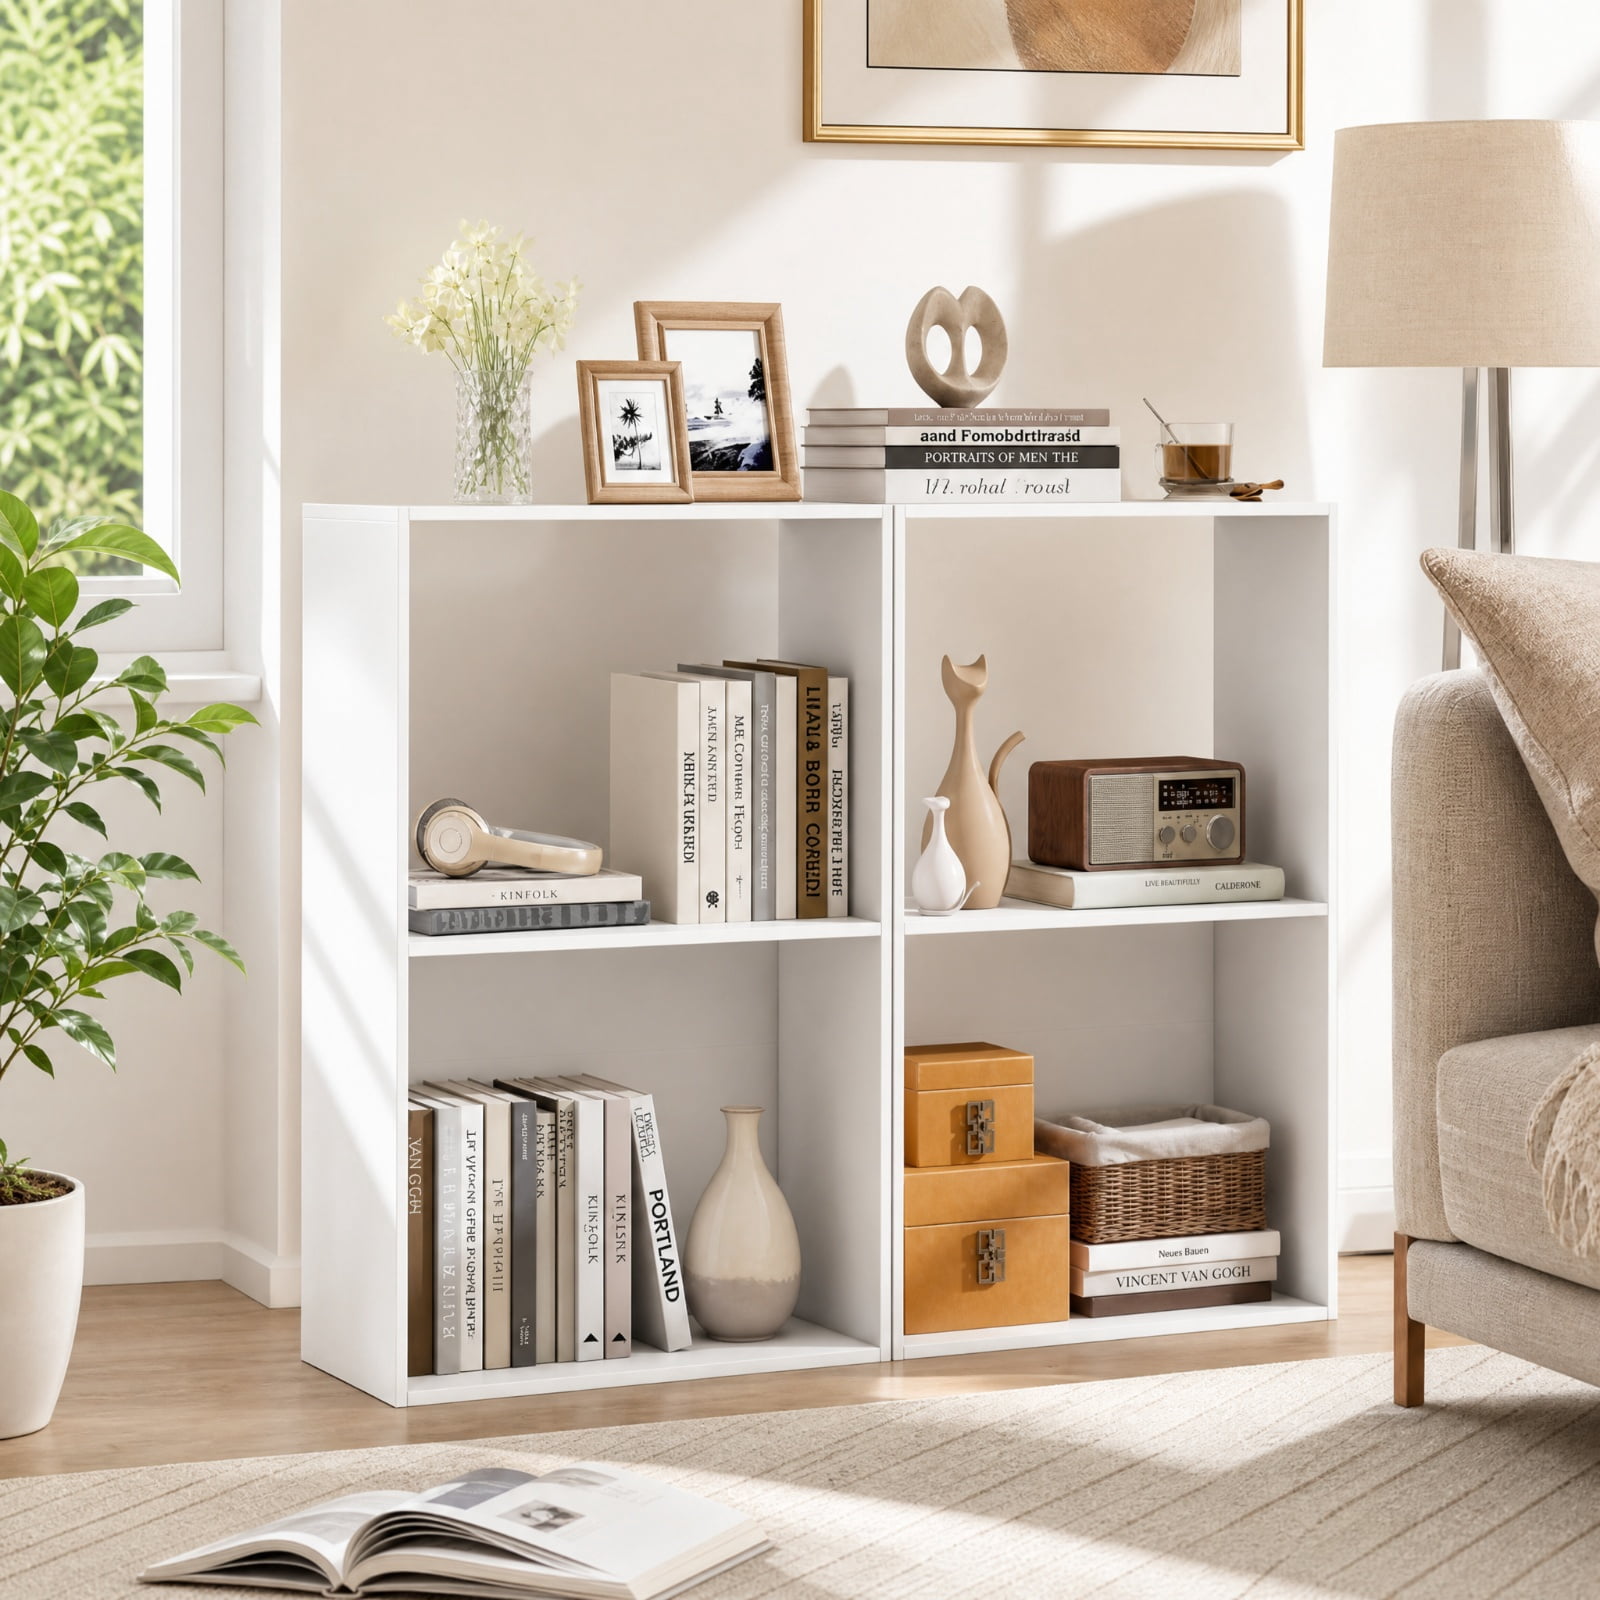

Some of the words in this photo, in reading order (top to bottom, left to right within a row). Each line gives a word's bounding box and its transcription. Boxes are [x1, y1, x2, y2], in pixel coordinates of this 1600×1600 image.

[925, 452, 995, 463] PORTRAITS
[998, 452, 1015, 463] OF
[1019, 452, 1048, 463] MEN
[1052, 452, 1079, 463] THE
[1145, 879, 1160, 888] LIVE
[1160, 878, 1201, 887] BEAUTIFULLY
[1214, 880, 1262, 891] CALDERONE
[500, 889, 558, 900] KINFOLK
[648, 1188, 681, 1304] PORTLAND
[1158, 1248, 1183, 1258] Neues
[1184, 1247, 1209, 1256] Bauen
[1116, 1272, 1178, 1288] VINCENT
[1181, 1269, 1209, 1282] VAN
[1212, 1265, 1251, 1279] GOGH
